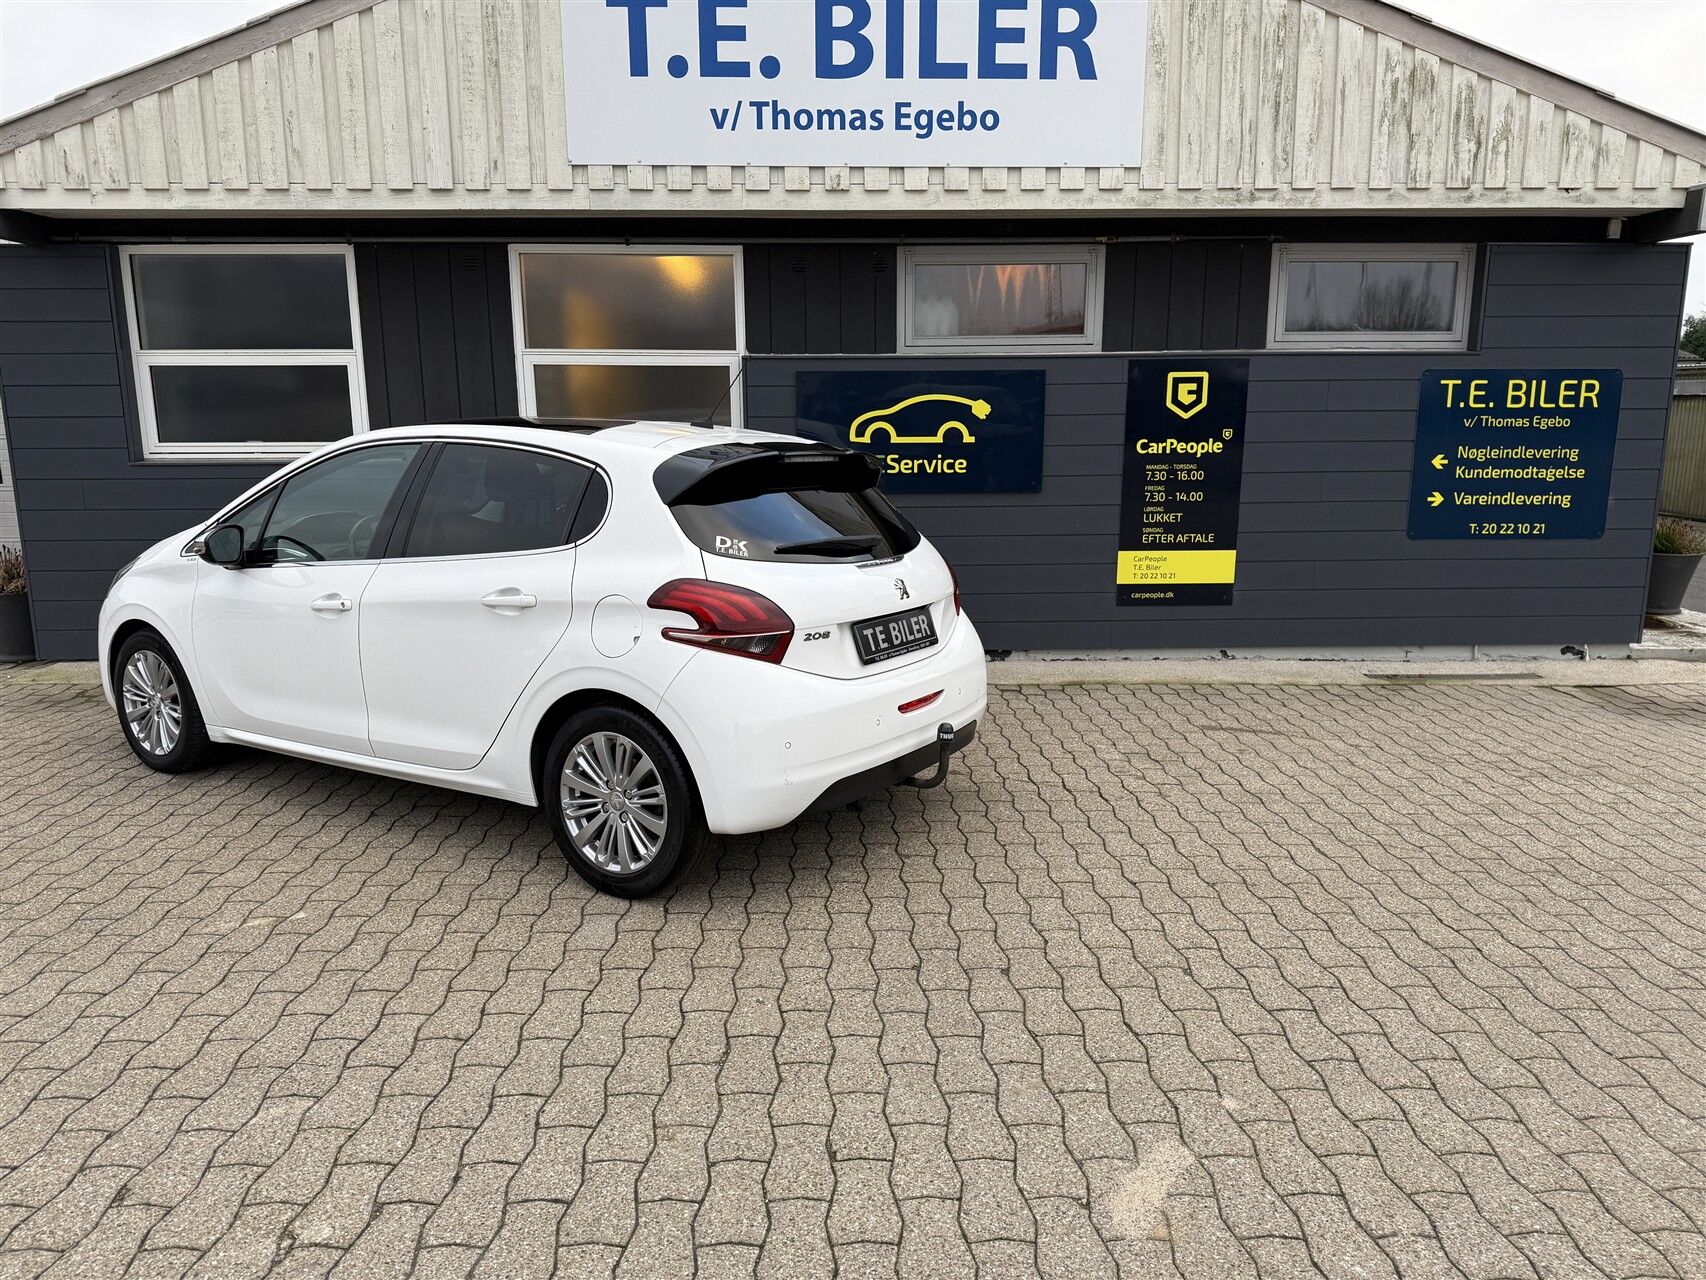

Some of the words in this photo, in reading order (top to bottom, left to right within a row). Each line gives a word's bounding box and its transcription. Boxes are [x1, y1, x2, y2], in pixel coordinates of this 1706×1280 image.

[605, 0, 781, 79] T.E.
[814, 0, 1098, 80] BILER
[709, 101, 742, 131] v/
[749, 100, 884, 131] Thomas
[894, 100, 1000, 139] Egebo
[1440, 379, 1494, 408] T.E.
[1506, 379, 1600, 408] BILER
[1463, 416, 1478, 428] v/
[1481, 415, 1530, 427] Thomas
[1533, 416, 1571, 430] Egebo
[1136, 438, 1223, 457] CarPeople
[1457, 446, 1580, 461] Nøgleindlevering
[1146, 471, 1167, 481] 7.30
[1177, 471, 1205, 481] 16.00
[1455, 466, 1586, 481] Kundemodtagelse
[1144, 492, 1166, 502] 7.30
[1176, 492, 1204, 502] 14.00
[1454, 492, 1572, 508] Vareindlevering
[1143, 513, 1183, 523] LUKKET
[1469, 523, 1479, 534] T:
[1481, 523, 1497, 534] 20
[1499, 523, 1515, 534] 22
[1517, 523, 1530, 534] 10
[1533, 523, 1545, 534] 21
[1142, 534, 1174, 544] EFTER
[1175, 533, 1215, 543] AFTALE
[728, 548, 749, 557] BILER
[1133, 555, 1168, 563] CarPeople
[1131, 591, 1175, 599] carpeople.dk
[803, 630, 831, 642] 208
[889, 614, 931, 645] BILER
